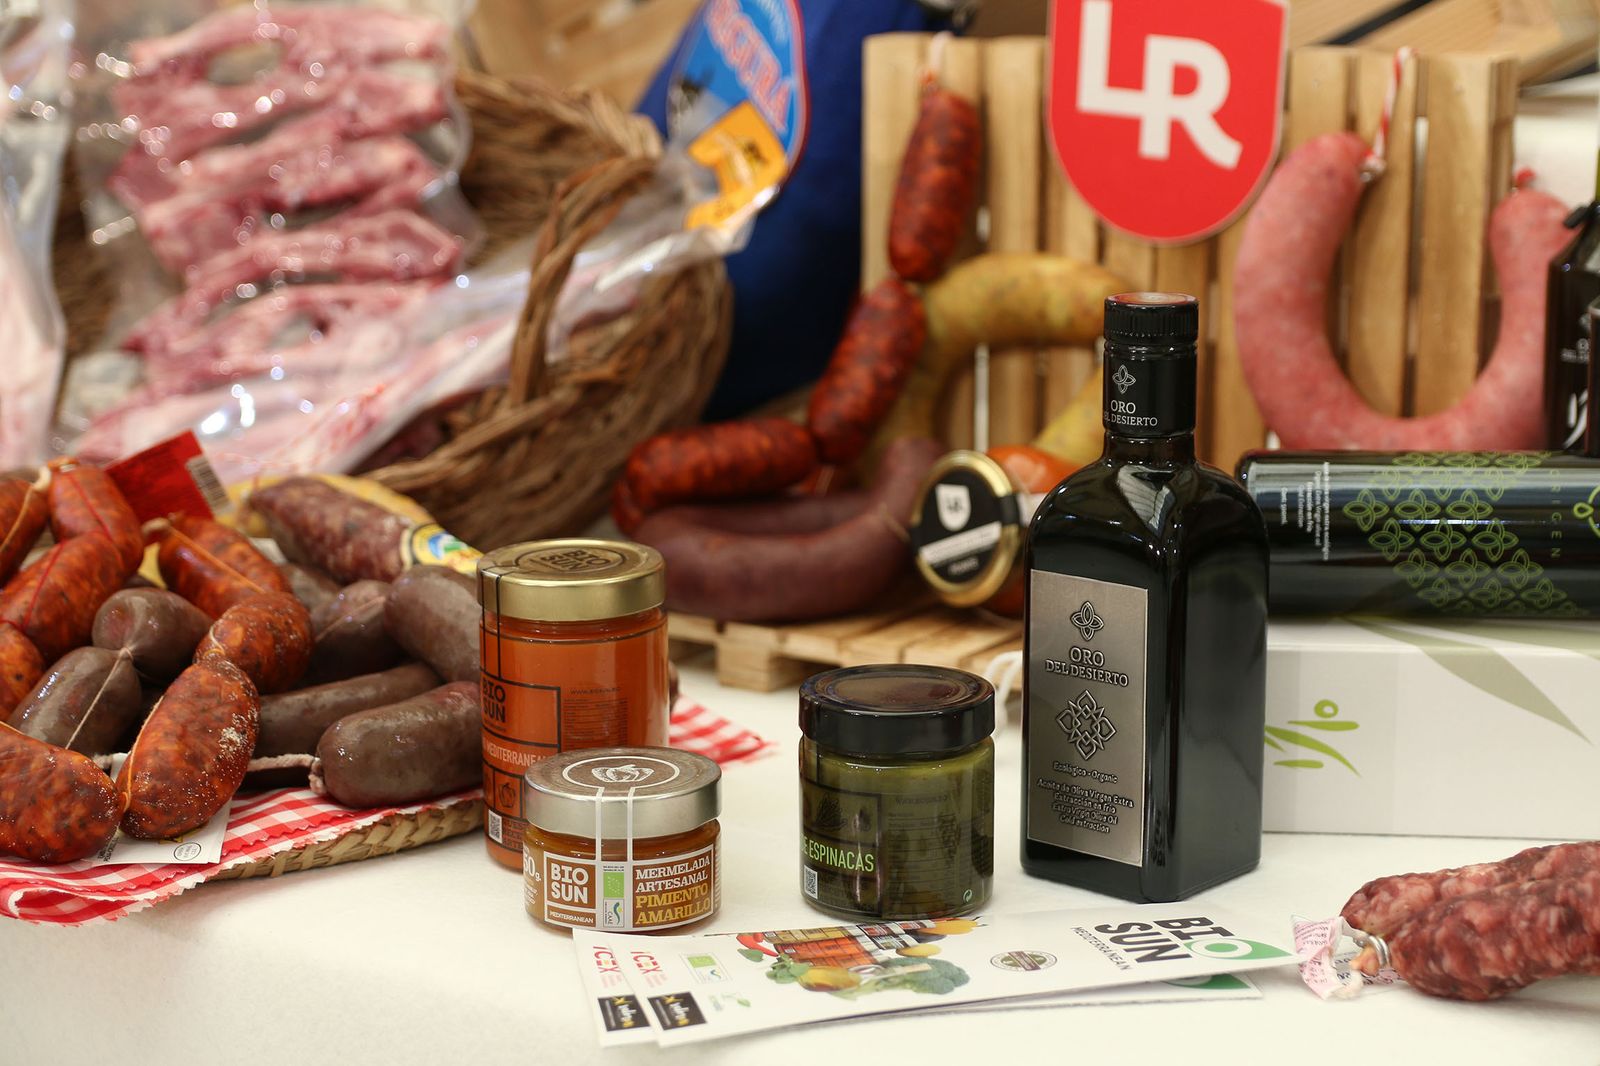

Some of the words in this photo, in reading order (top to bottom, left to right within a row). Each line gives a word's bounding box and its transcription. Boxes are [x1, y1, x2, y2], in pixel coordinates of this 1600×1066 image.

[1076, 0, 1242, 170] LR
[1110, 400, 1136, 414] ORO
[1111, 413, 1158, 427] DESIERTO
[540, 554, 590, 570] SUN
[563, 550, 611, 565] BIO
[1069, 646, 1105, 667] ORO
[1045, 659, 1069, 675] DEL
[1070, 664, 1129, 687] DESIERTO
[482, 679, 506, 702] BIO
[482, 697, 506, 723] SUN
[487, 741, 548, 768] MEDITERRANEA
[1053, 761, 1087, 777] Ecológico
[1091, 770, 1118, 783] Organic
[1037, 778, 1060, 790] Aceite
[1061, 783, 1070, 793] de
[1070, 786, 1088, 797] Oliva
[1089, 789, 1112, 803] Virgen
[1113, 795, 1134, 808] Extra
[1092, 802, 1102, 811] en
[1060, 814, 1076, 825] Cold
[1076, 819, 1110, 833] extraction
[809, 839, 874, 872] ESPINACAS
[551, 863, 589, 885] BIO
[636, 855, 711, 880] MERMELADA
[551, 881, 588, 904] SUN
[636, 870, 708, 893] ARTESANAL
[636, 882, 708, 909] PIMIENTO
[550, 910, 594, 924] MEDITERRANEAN
[635, 897, 711, 924] AMARILLO
[1070, 926, 1132, 971] MEDITERRANEAN
[1095, 921, 1193, 964] SUN
[1153, 917, 1253, 960] BIO
